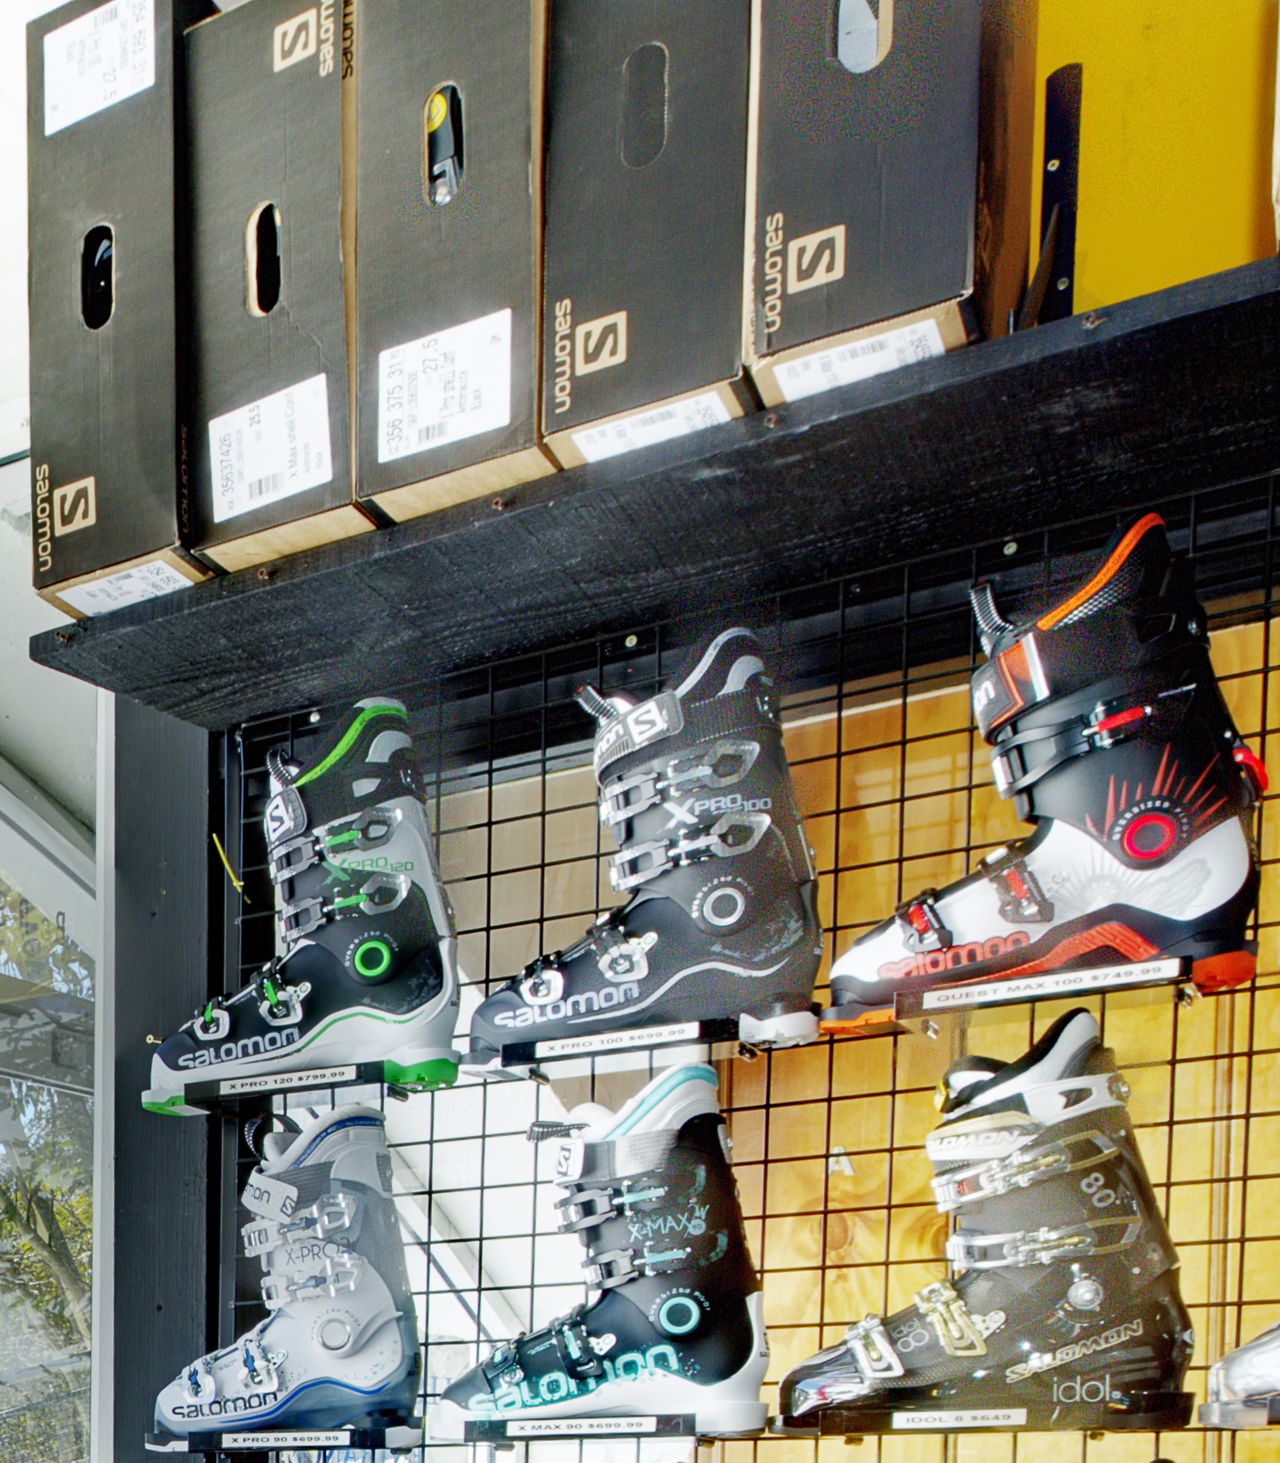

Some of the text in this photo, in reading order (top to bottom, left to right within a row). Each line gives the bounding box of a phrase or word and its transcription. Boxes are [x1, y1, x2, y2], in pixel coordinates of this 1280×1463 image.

[765, 212, 783, 333] salomon
[554, 298, 572, 414] salomon
[36, 463, 52, 571] salomon
[877, 931, 1030, 982] salomon
[936, 963, 1164, 1003] QUEST MAX 100 $749.99
[494, 982, 640, 1029] salomon
[178, 1026, 301, 1070] salomon
[547, 1028, 687, 1053] X PRO 100 $699.99
[228, 1070, 347, 1091] X PRO 120 $799.99
[628, 1213, 692, 1243] X-MAX
[1006, 1320, 1144, 1384] SALOMON
[172, 1391, 278, 1420] salomon
[905, 1415, 948, 1425] IDOL
[970, 1412, 1013, 1425] $649
[231, 1434, 340, 1444] X PRO 90 $699.99
[517, 1421, 644, 1432] X MAX 90 $699.99
